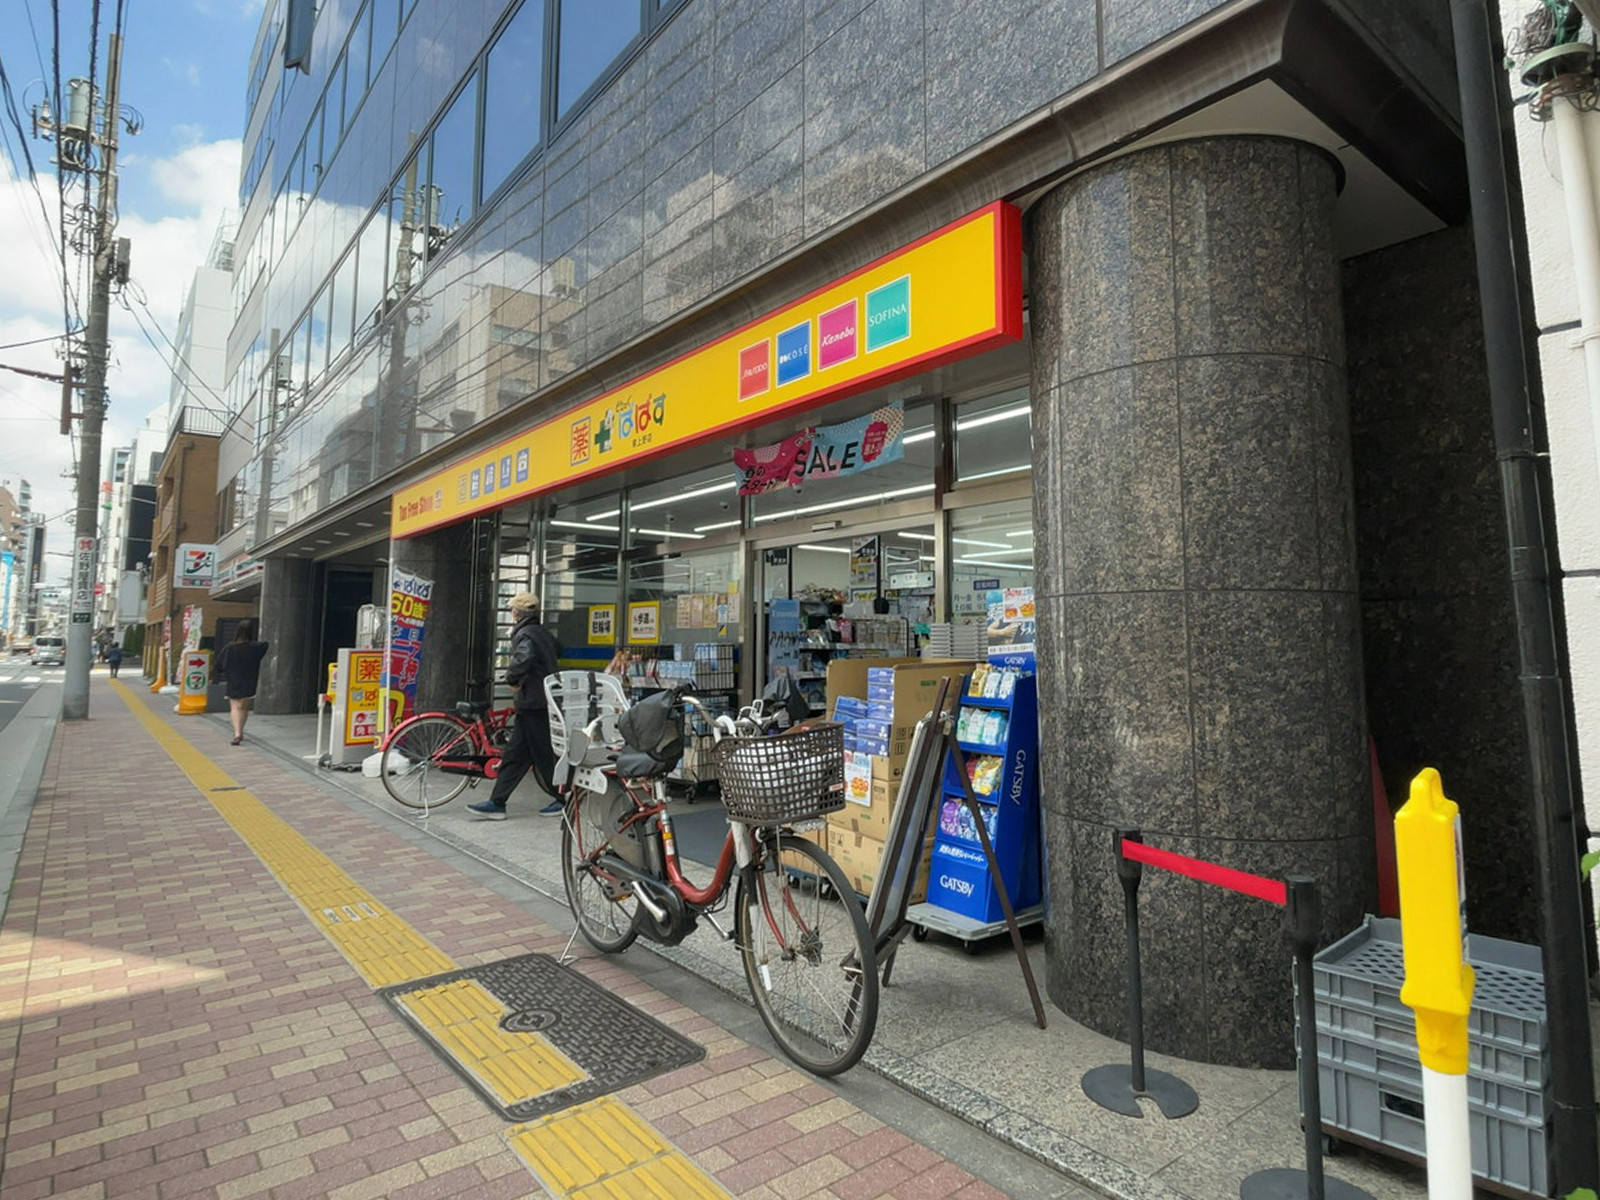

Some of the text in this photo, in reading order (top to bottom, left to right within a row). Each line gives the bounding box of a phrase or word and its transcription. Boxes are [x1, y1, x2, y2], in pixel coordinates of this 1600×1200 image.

[868, 303, 908, 327] SOFINA
[821, 326, 855, 347] Kanebo
[573, 423, 589, 461] 薬
[794, 441, 859, 478] SALE
[359, 658, 382, 681] 薬
[1004, 656, 1027, 665] GATSBY
[1009, 748, 1027, 806] GATSBY
[939, 874, 975, 898] GATSBY
